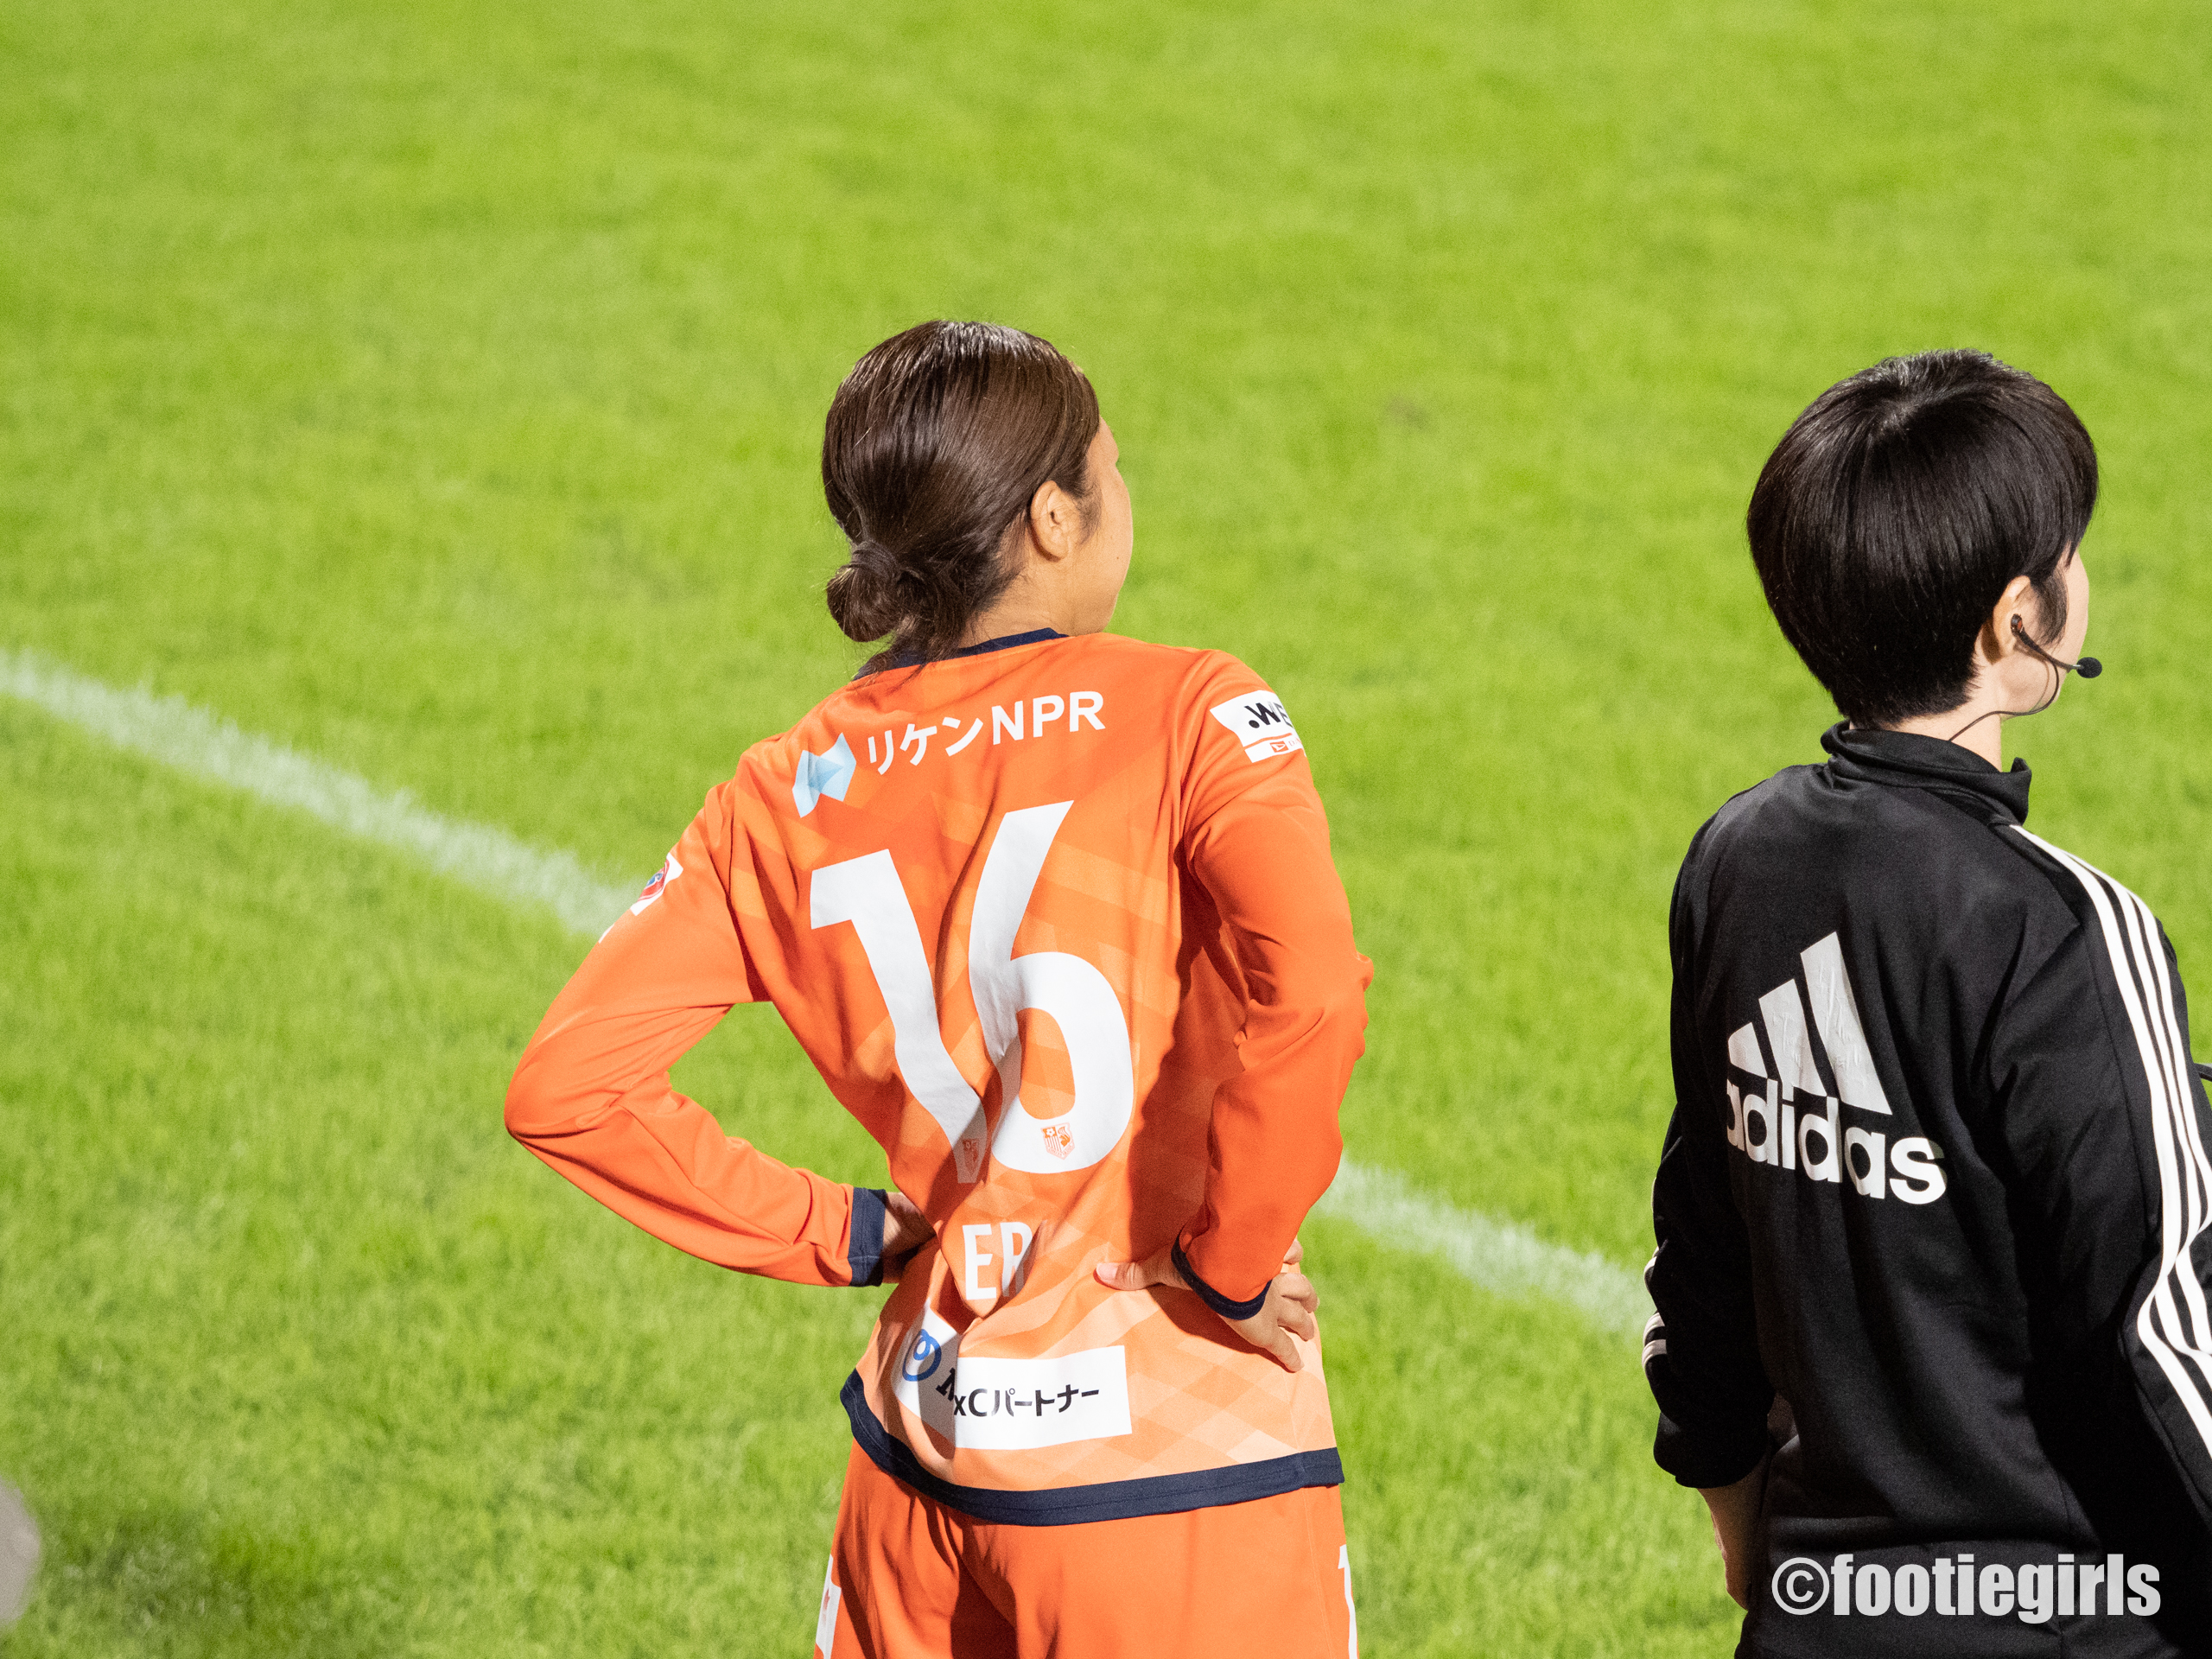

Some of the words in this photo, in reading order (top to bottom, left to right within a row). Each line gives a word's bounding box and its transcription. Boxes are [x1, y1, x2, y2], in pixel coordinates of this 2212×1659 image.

[868, 691, 1106, 776] リケンNPR
[810, 800, 1135, 1184] 16
[1726, 1077, 1947, 1205] adidas
